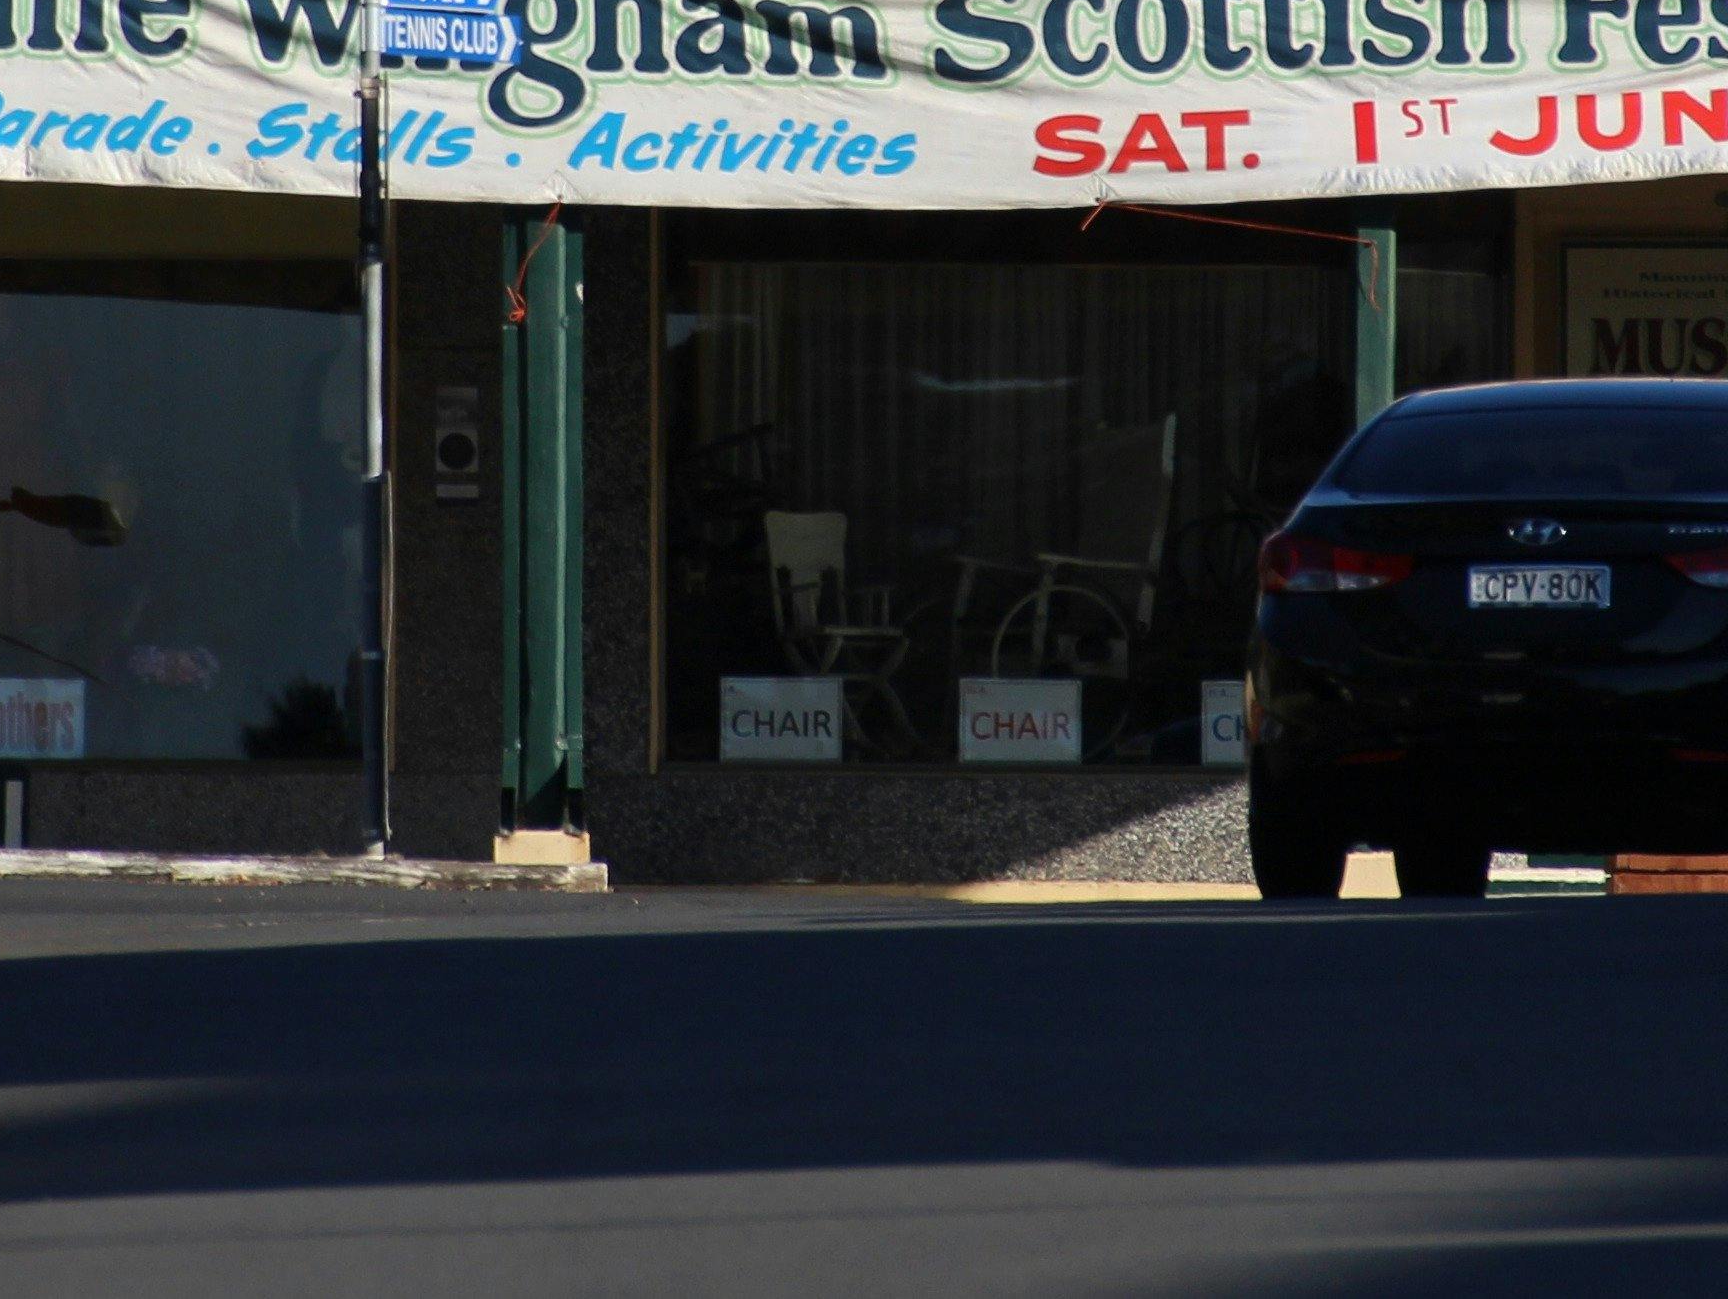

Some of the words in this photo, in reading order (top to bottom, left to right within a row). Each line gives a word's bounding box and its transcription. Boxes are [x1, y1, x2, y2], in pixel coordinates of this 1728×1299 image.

[384, 14, 447, 51] TENNIS
[450, 17, 499, 55] CLUB
[568, 112, 917, 177] Activities
[1031, 109, 1261, 178] SAT.
[731, 708, 833, 739] CHAIR
[971, 710, 1072, 741] CHAIR
